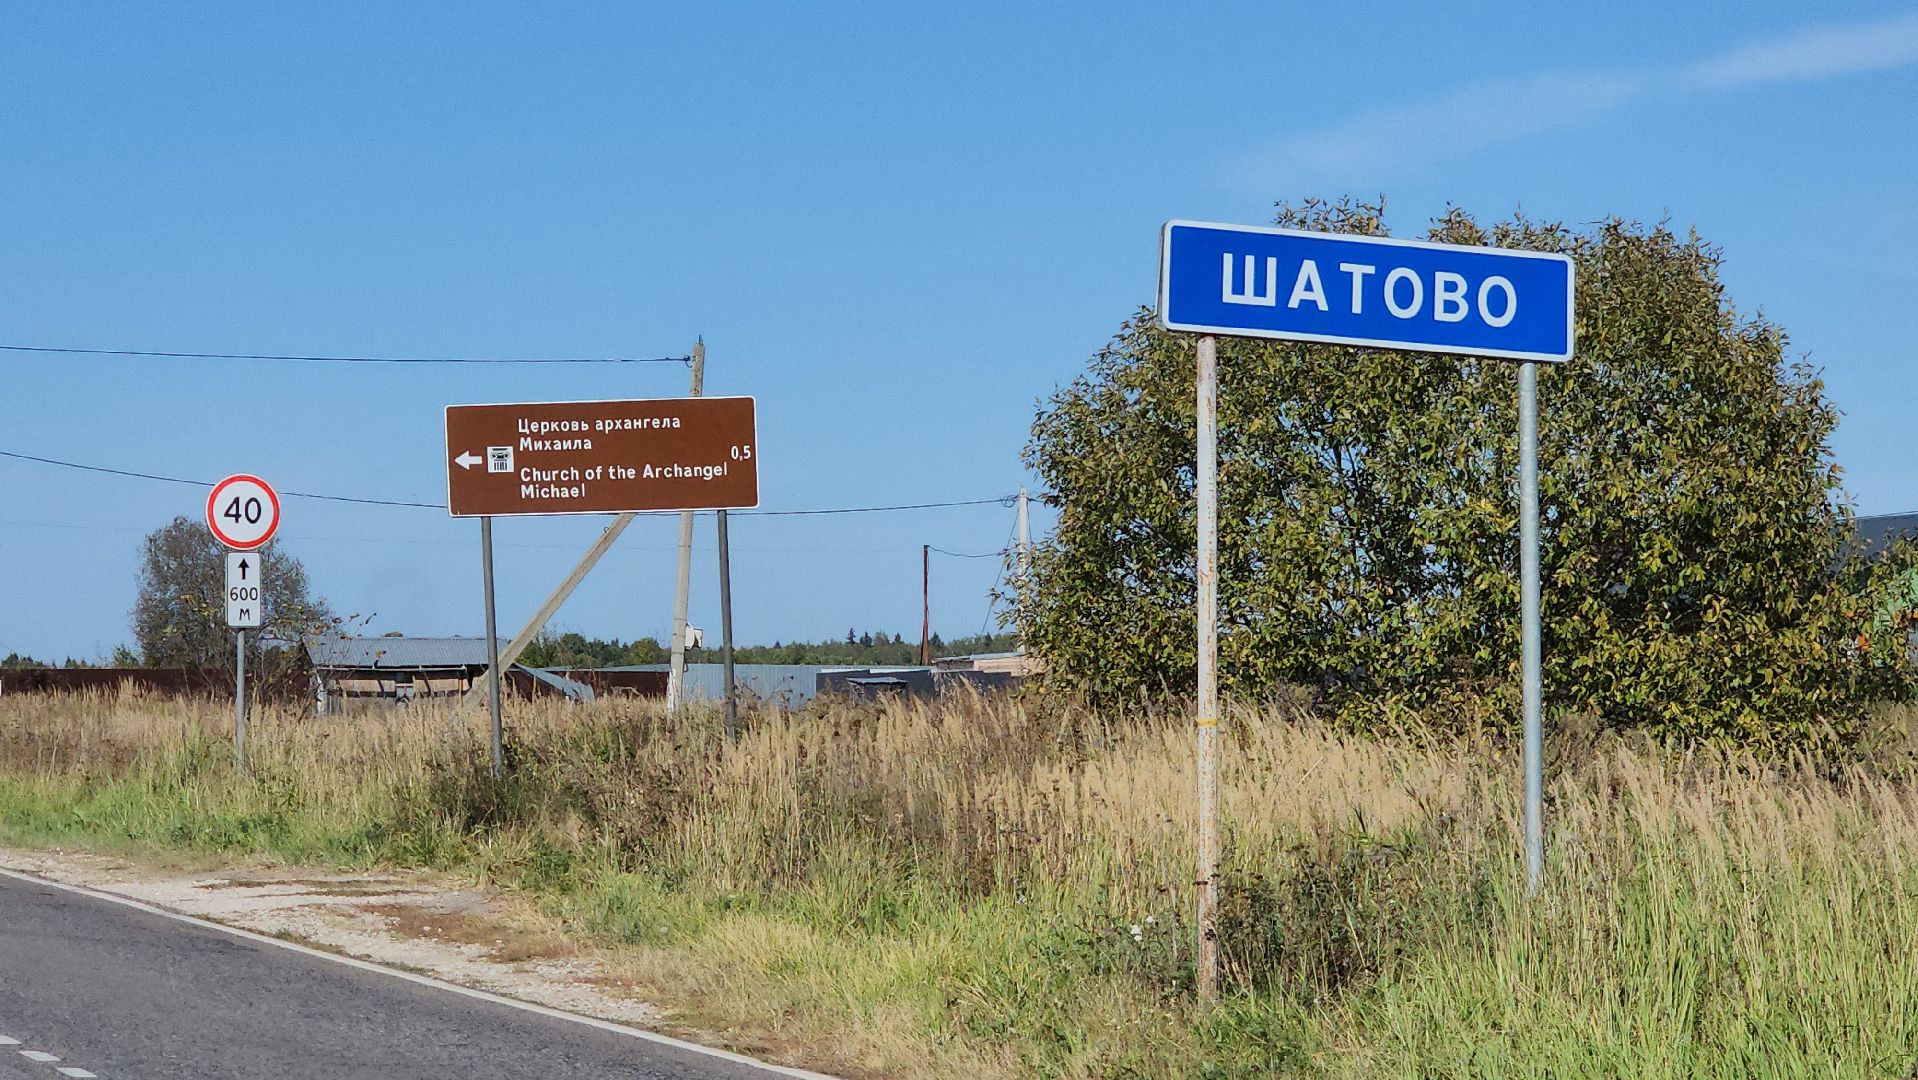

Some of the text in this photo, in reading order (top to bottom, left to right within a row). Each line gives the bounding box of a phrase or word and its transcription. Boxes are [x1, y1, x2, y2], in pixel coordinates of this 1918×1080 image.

[1222, 253, 1517, 328] ШАТОВО
[518, 416, 681, 434] Церковь архангела
[519, 437, 592, 452] Михаила
[730, 445, 751, 462] 0,5
[520, 462, 728, 482] Church of the Archangel
[521, 483, 586, 499] Michael
[224, 497, 262, 524] 40
[229, 587, 258, 601] 600
